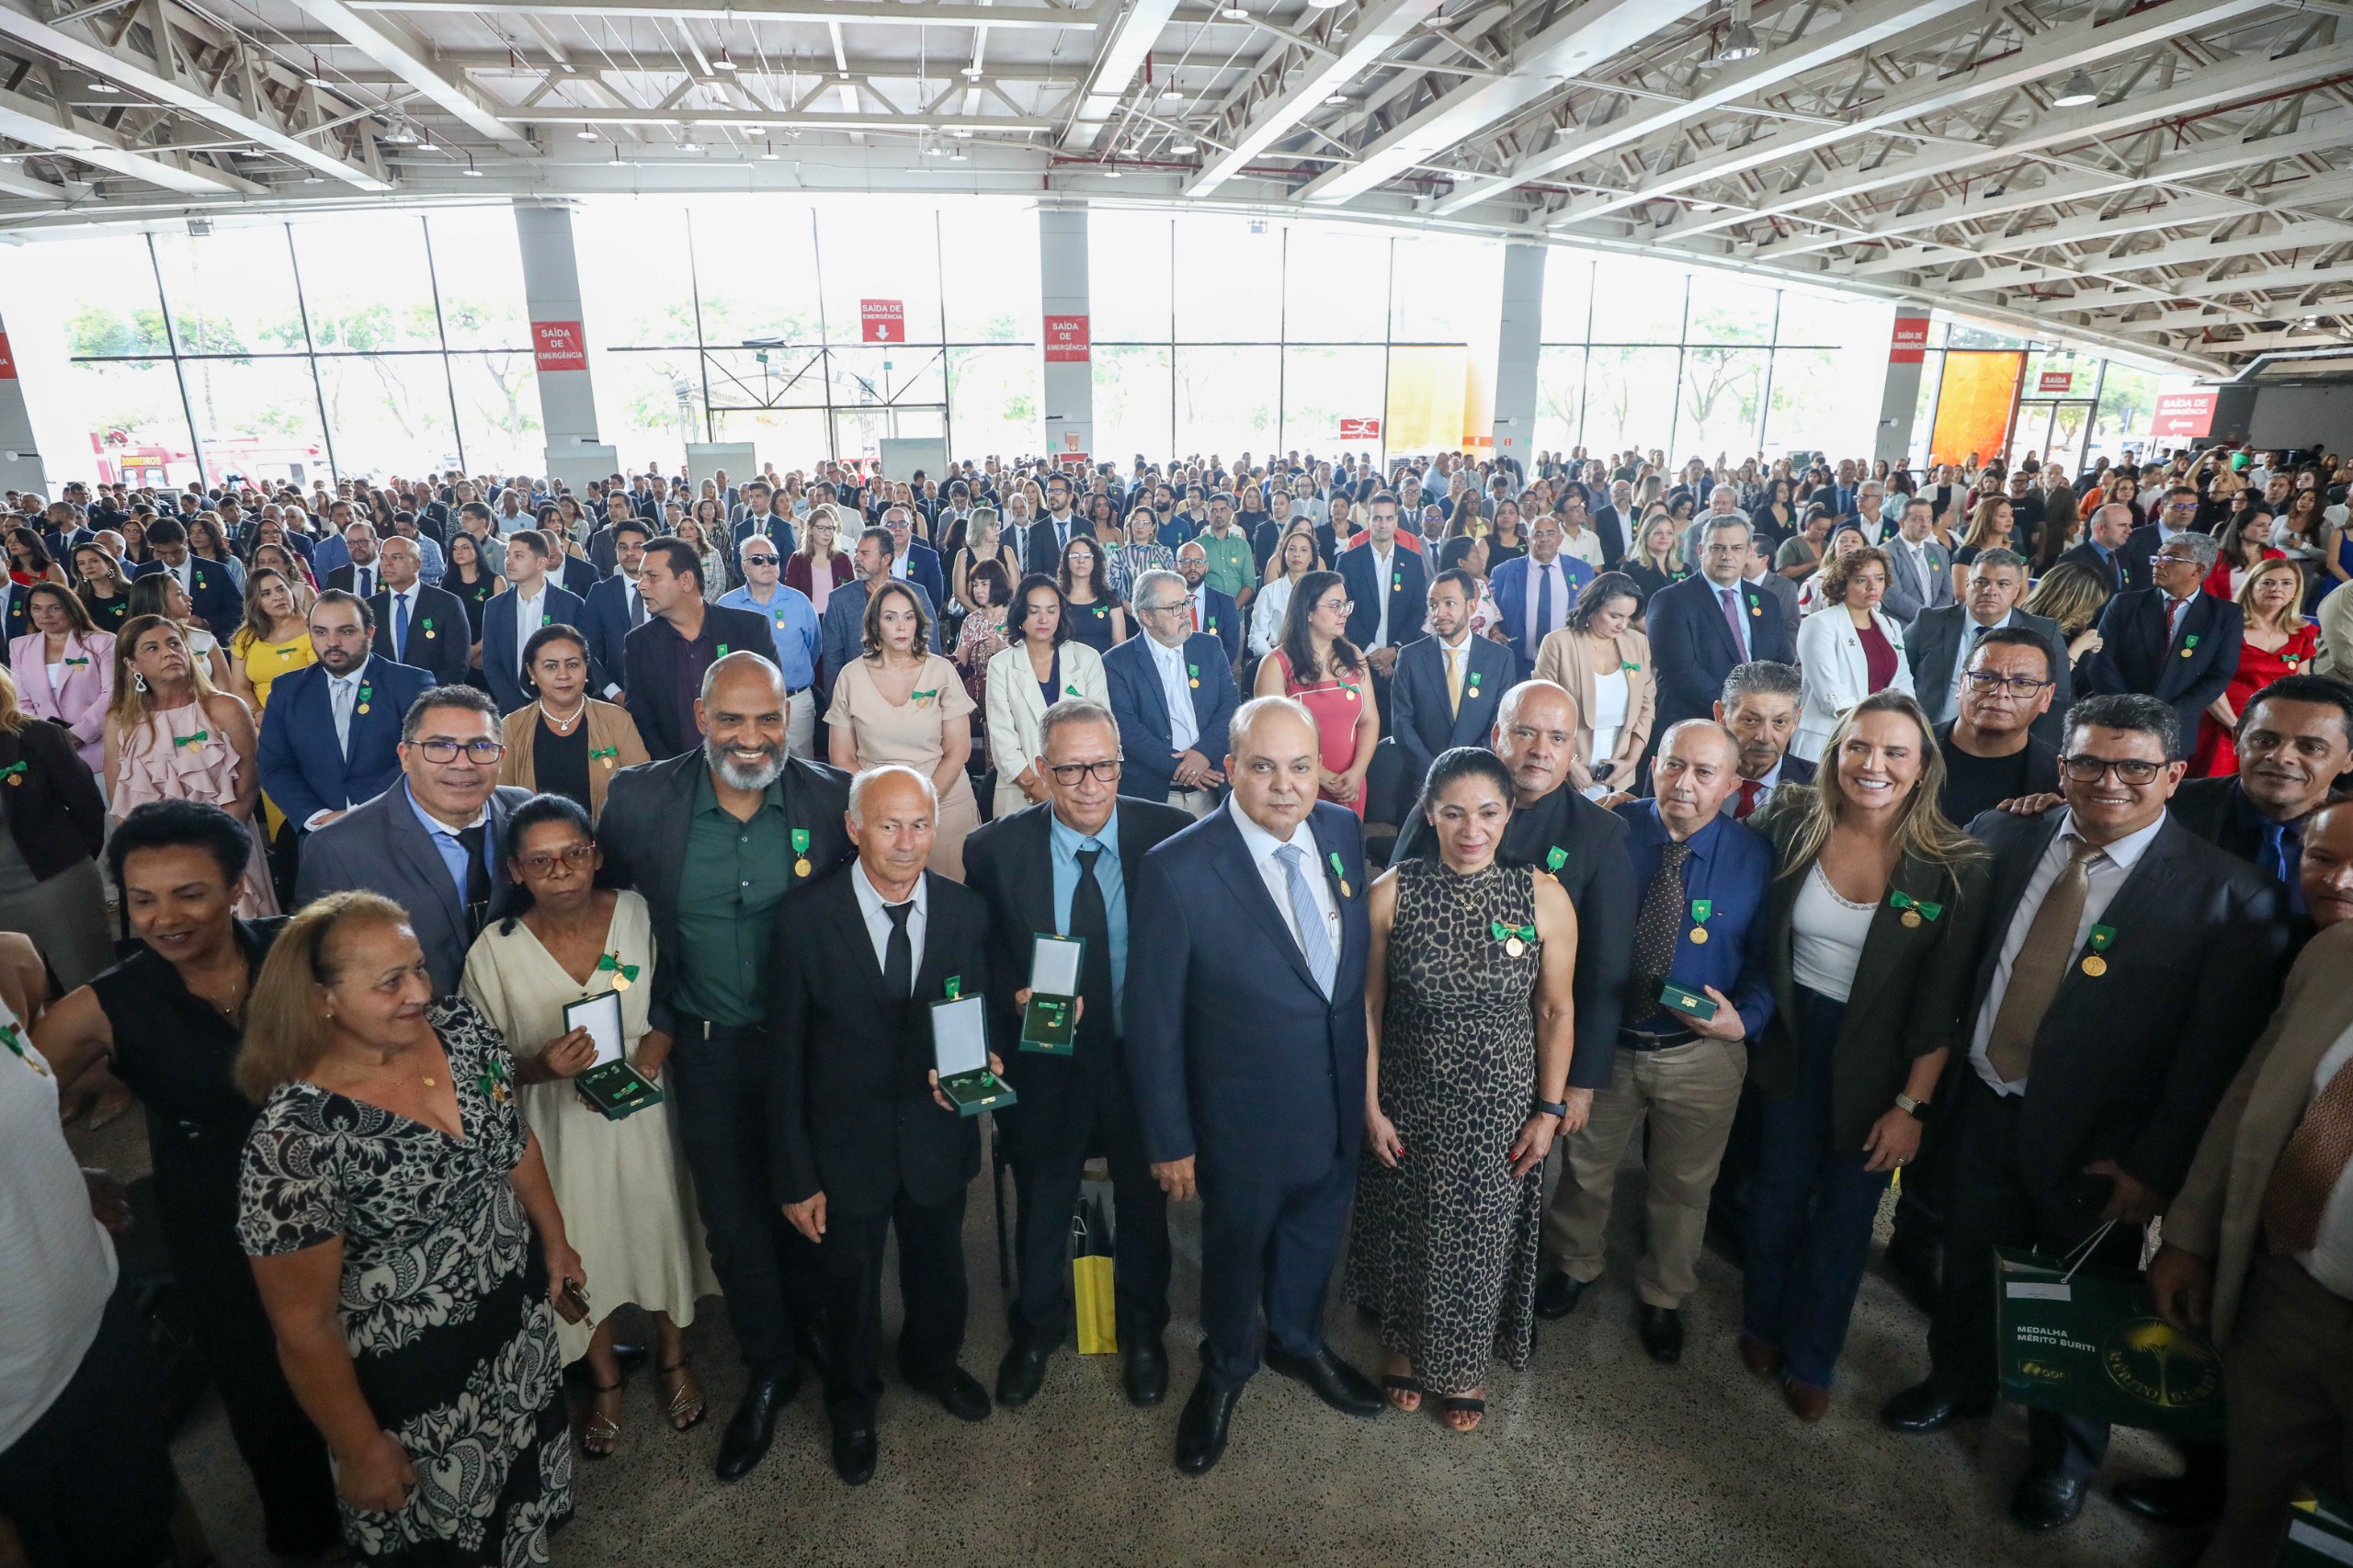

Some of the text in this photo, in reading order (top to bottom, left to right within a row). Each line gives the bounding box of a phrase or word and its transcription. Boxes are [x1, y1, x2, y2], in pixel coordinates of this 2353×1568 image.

[862, 303, 889, 312] SAÍDA
[1052, 321, 1078, 330] SAÍDA
[541, 327, 571, 337] SAÍDA
[1897, 331, 1915, 339] SAÍDA
[539, 350, 583, 359] EMERGÊNCIA
[2045, 375, 2067, 383] SAÍDA
[2163, 398, 2209, 408] SAÍDA DE
[121, 456, 162, 466] BOMBEIROS
[2017, 1325, 2068, 1337] MEDALHA
[2017, 1334, 2096, 1353] MÉRITO BURITI
